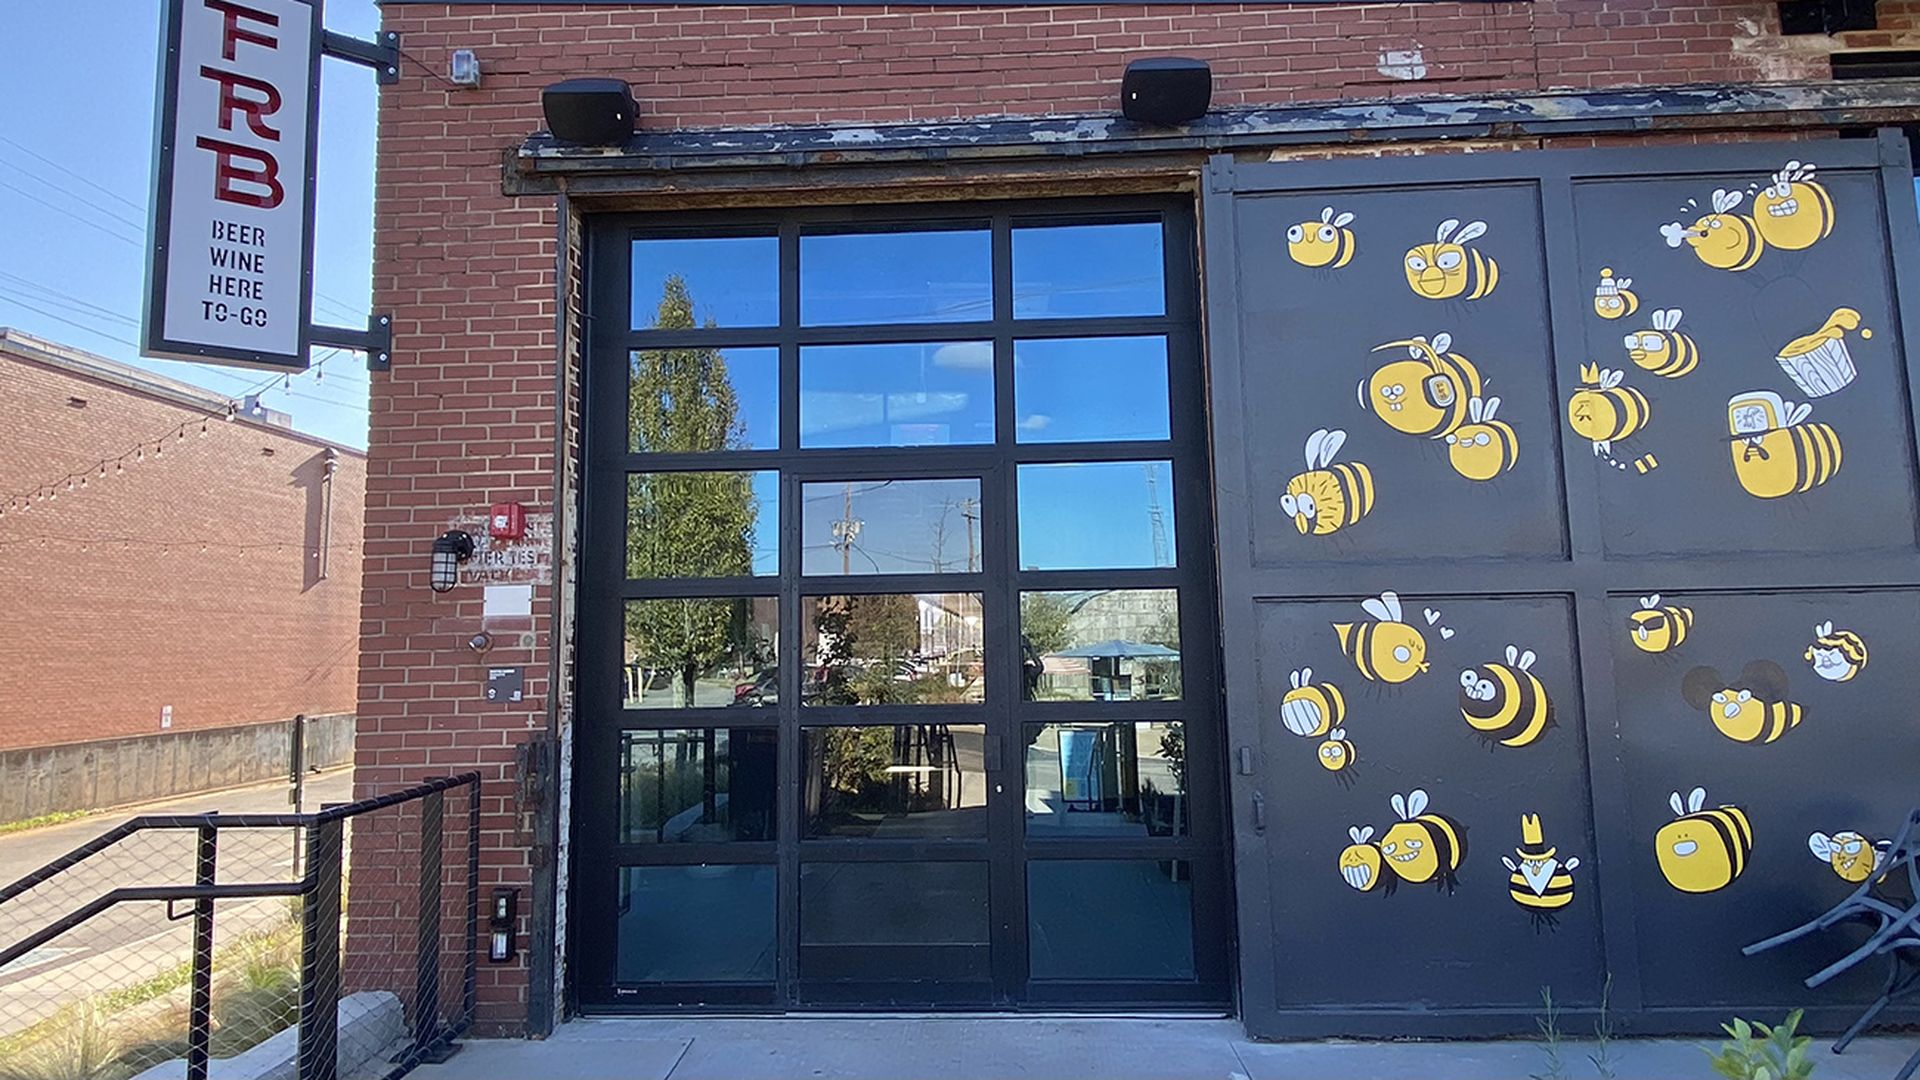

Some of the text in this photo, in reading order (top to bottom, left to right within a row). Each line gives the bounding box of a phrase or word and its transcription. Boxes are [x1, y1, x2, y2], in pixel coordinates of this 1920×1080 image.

[212, 220, 265, 247] BEER
[210, 246, 265, 273] WINE
[209, 274, 263, 300] HERE
[202, 300, 267, 327] TO-GO
